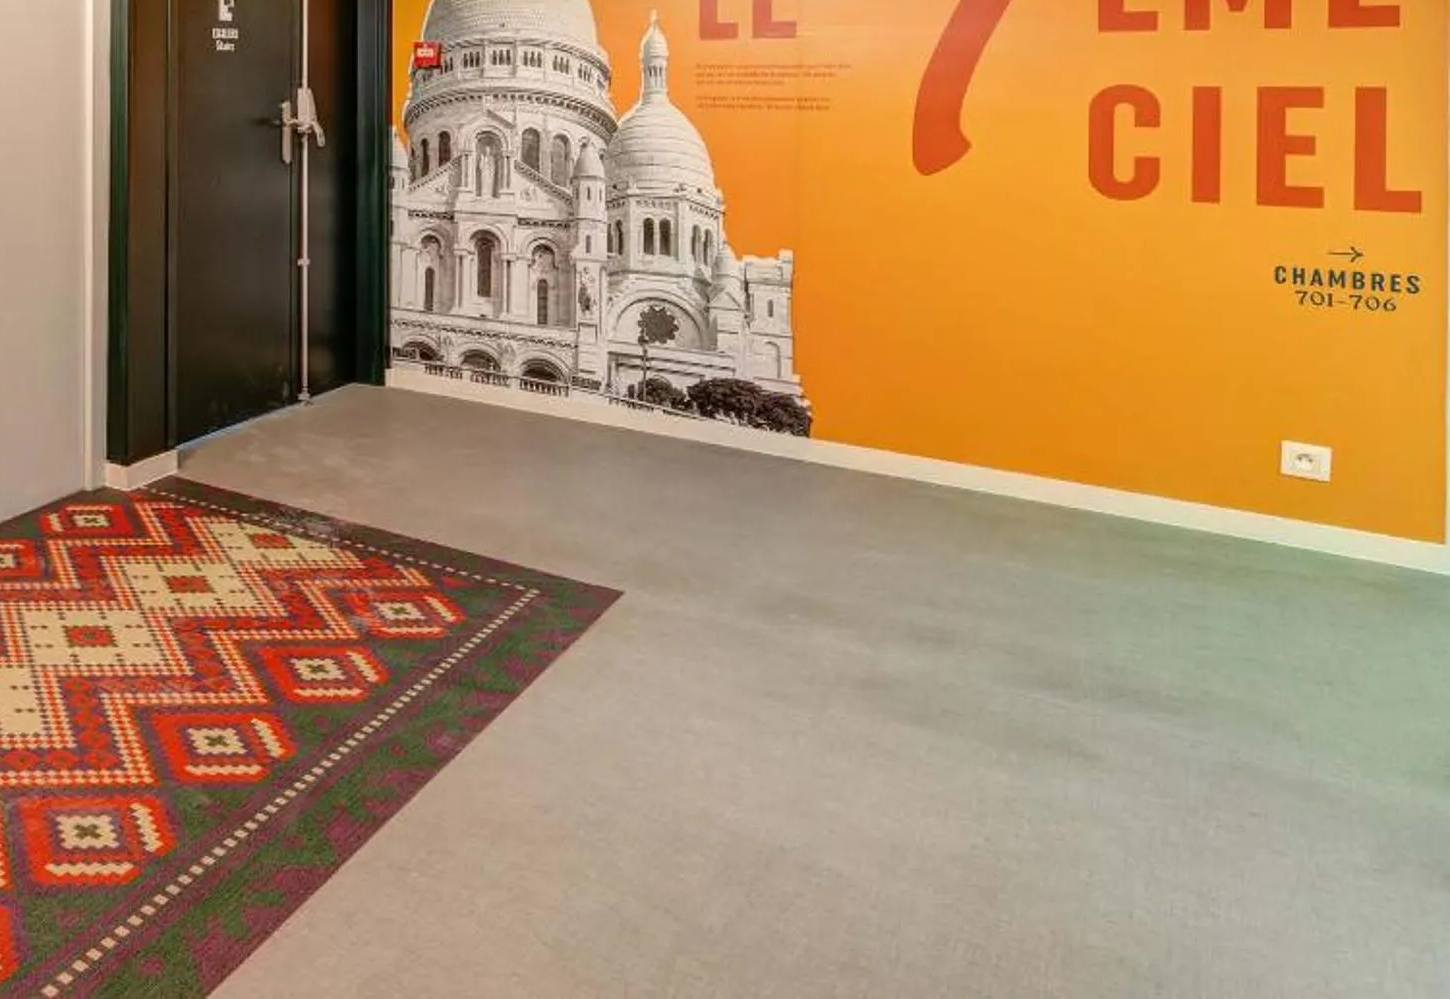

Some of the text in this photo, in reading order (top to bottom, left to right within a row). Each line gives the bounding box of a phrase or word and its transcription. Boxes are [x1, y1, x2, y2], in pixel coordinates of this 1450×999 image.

[1087, 84, 1423, 214] CIEL
[1274, 265, 1421, 295] CHAMBRES
[1295, 290, 1397, 312] 701-706
